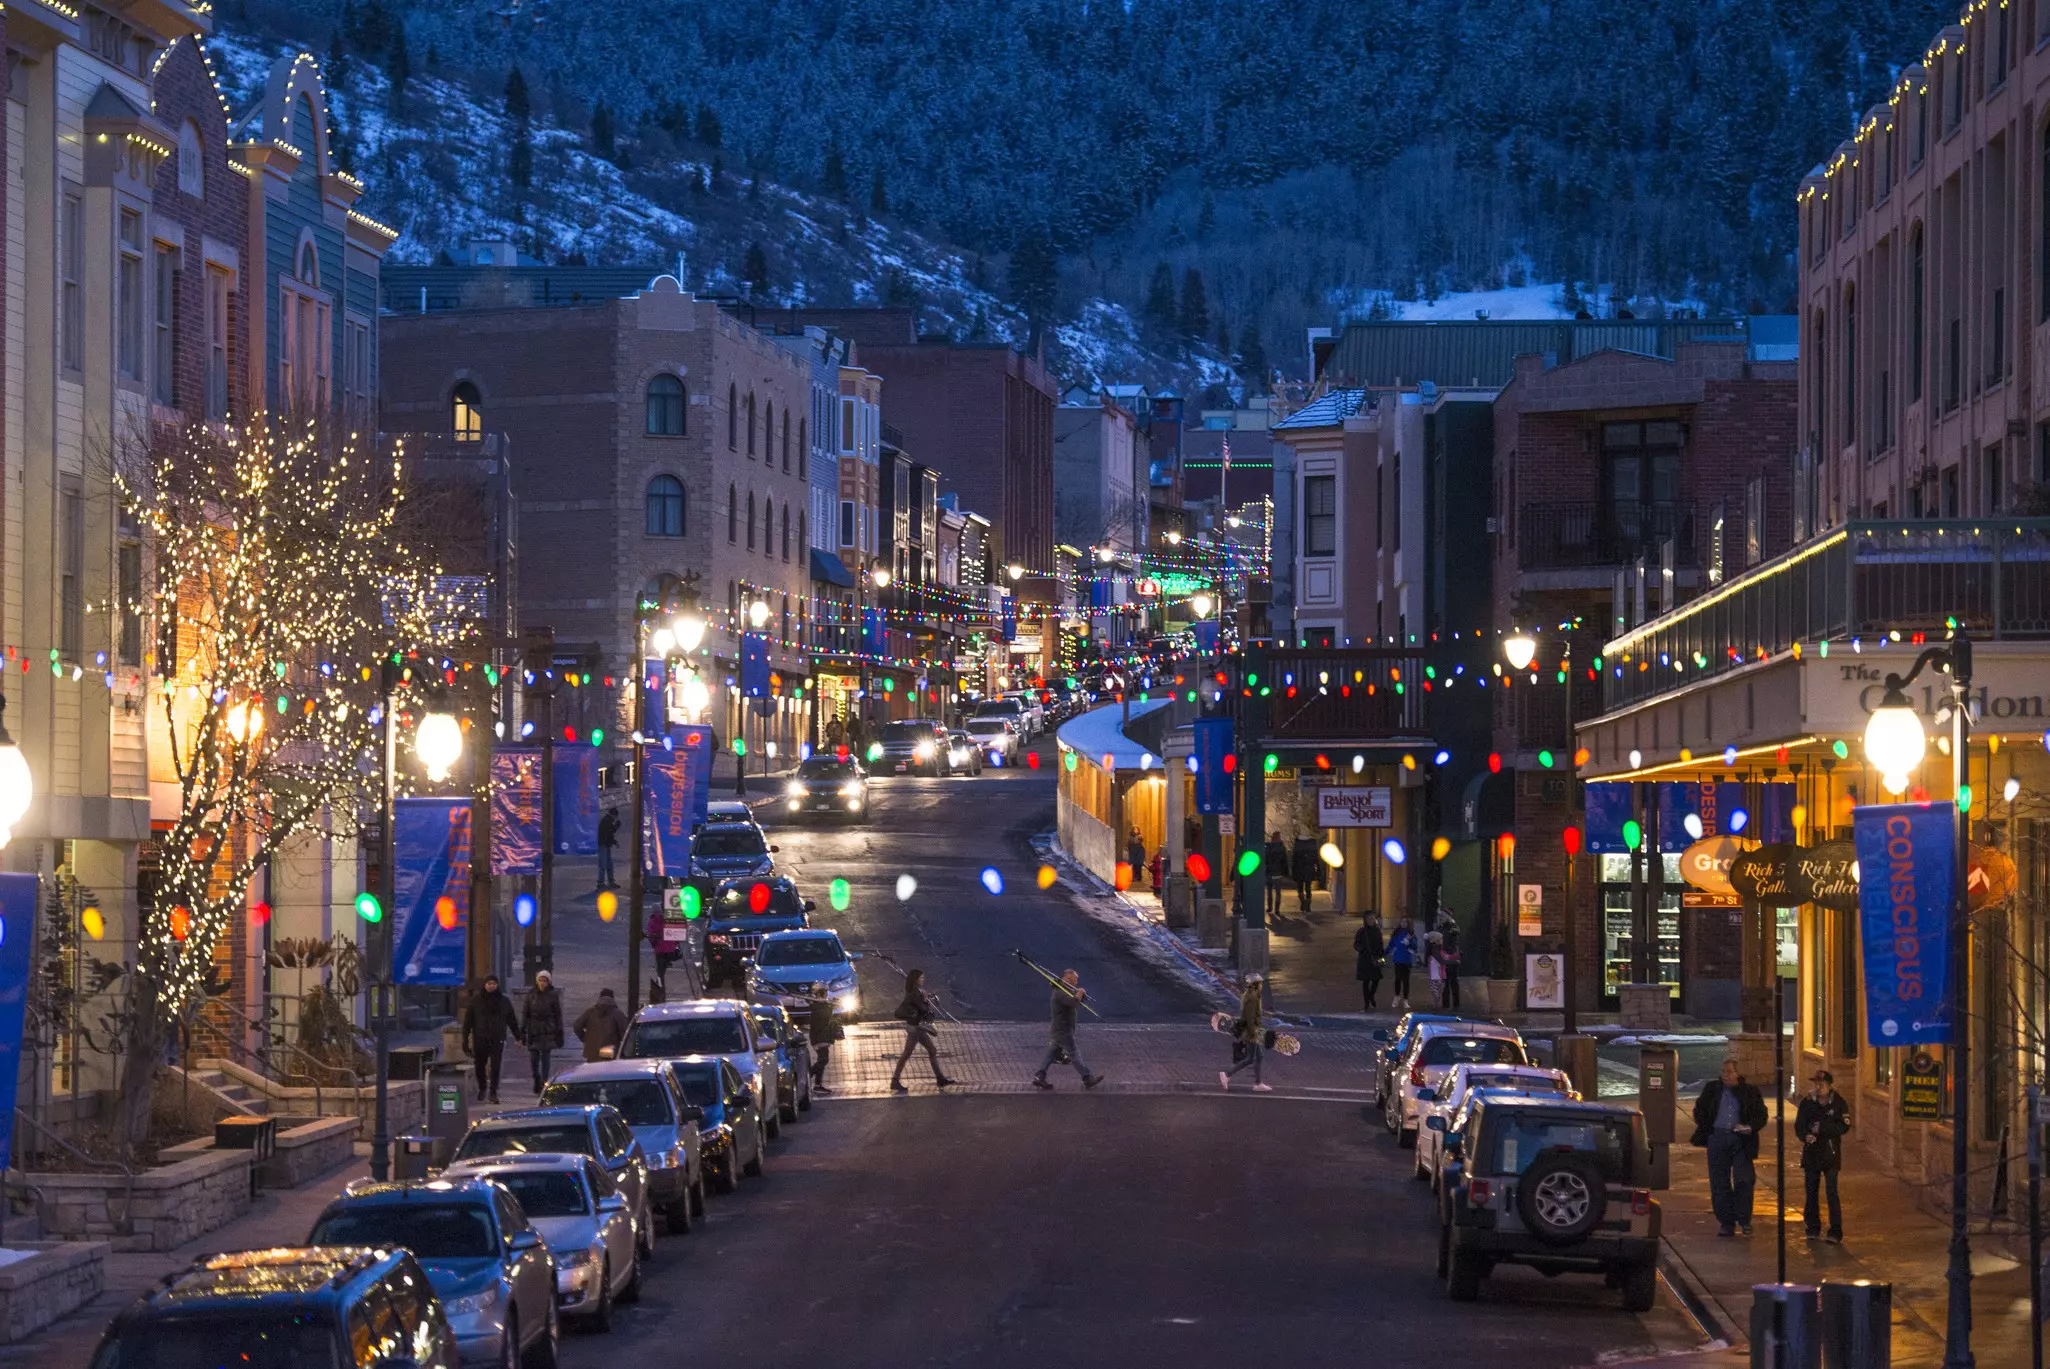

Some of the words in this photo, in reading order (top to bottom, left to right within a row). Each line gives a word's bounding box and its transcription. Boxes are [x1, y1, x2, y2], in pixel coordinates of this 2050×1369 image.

[1840, 664, 1880, 681] The
[1744, 862, 1772, 879] Rich
[1798, 860, 1831, 879] Rich
[1712, 896, 1725, 904] 7th
[1727, 896, 1738, 904] St
[1887, 815, 1922, 1001] CONSCIOUS
